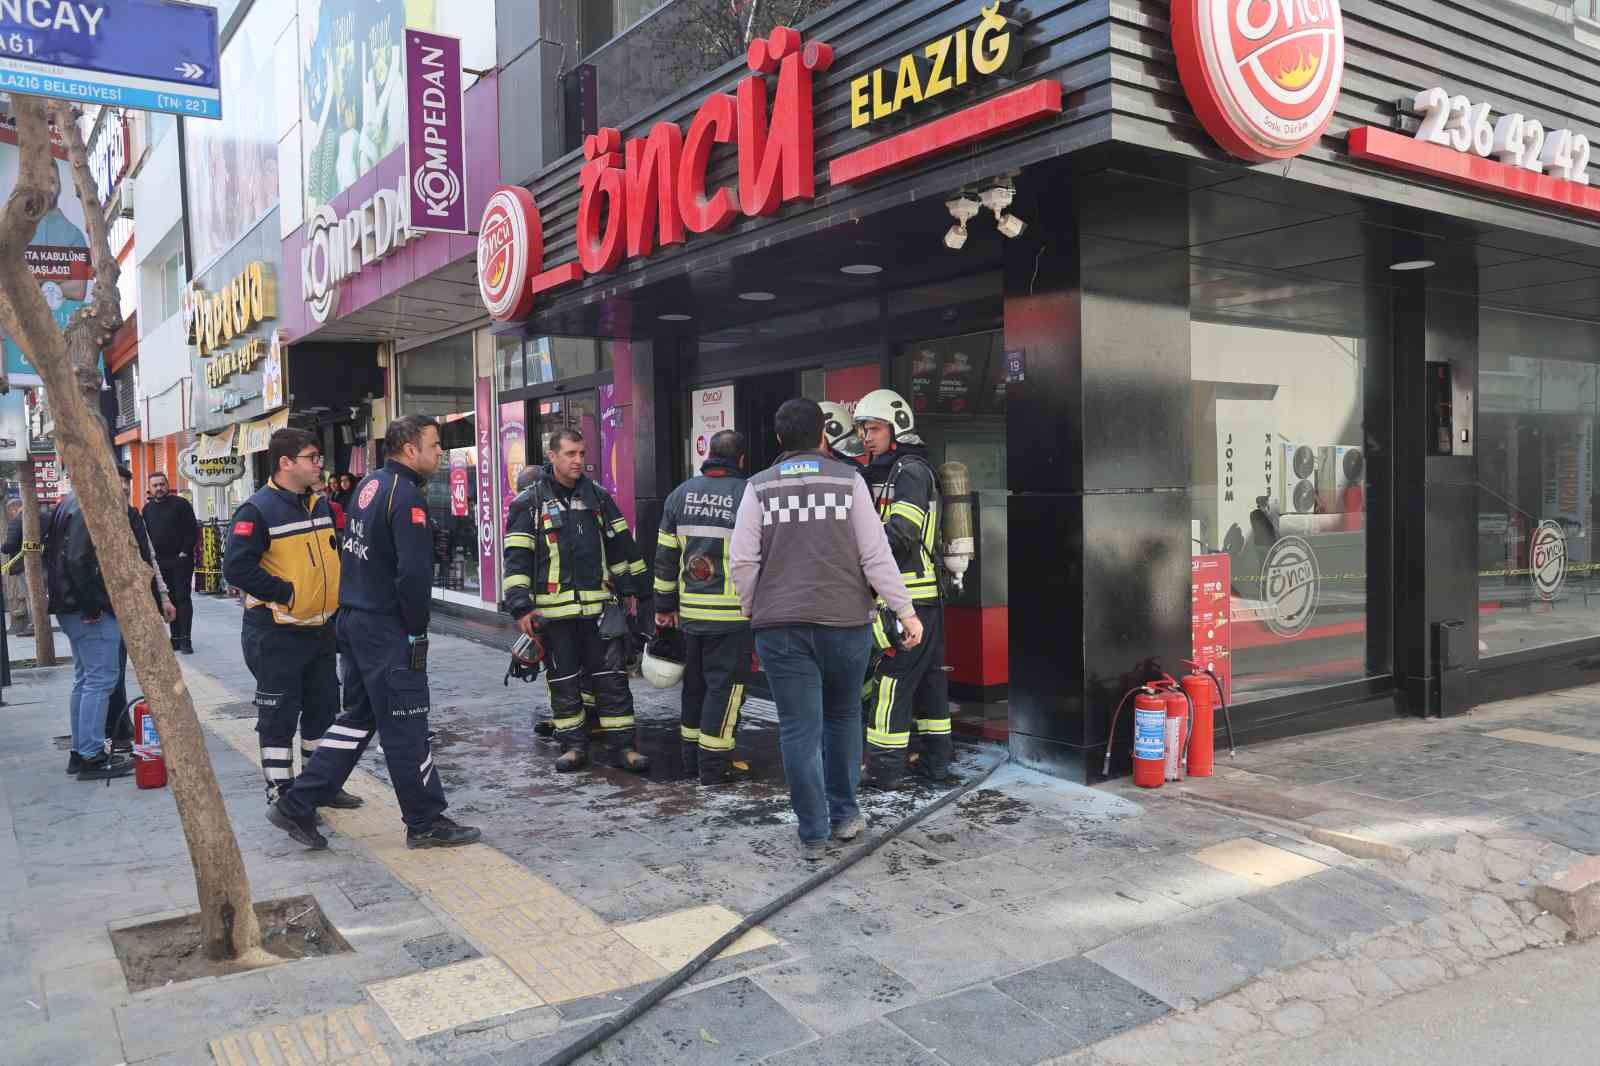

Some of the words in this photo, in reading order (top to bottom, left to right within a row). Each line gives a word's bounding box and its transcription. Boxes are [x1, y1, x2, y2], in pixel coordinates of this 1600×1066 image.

[850, 0, 1011, 129] ELAZIĞ
[415, 46, 457, 217] KOMPEDAN
[1414, 87, 1494, 157] 236
[1496, 113, 1544, 173] 42
[1542, 128, 1591, 185] 42
[301, 176, 412, 304] KOMPEDA
[480, 430, 493, 557] KOMPEDAN
[683, 504, 731, 520] İTFAİYE
